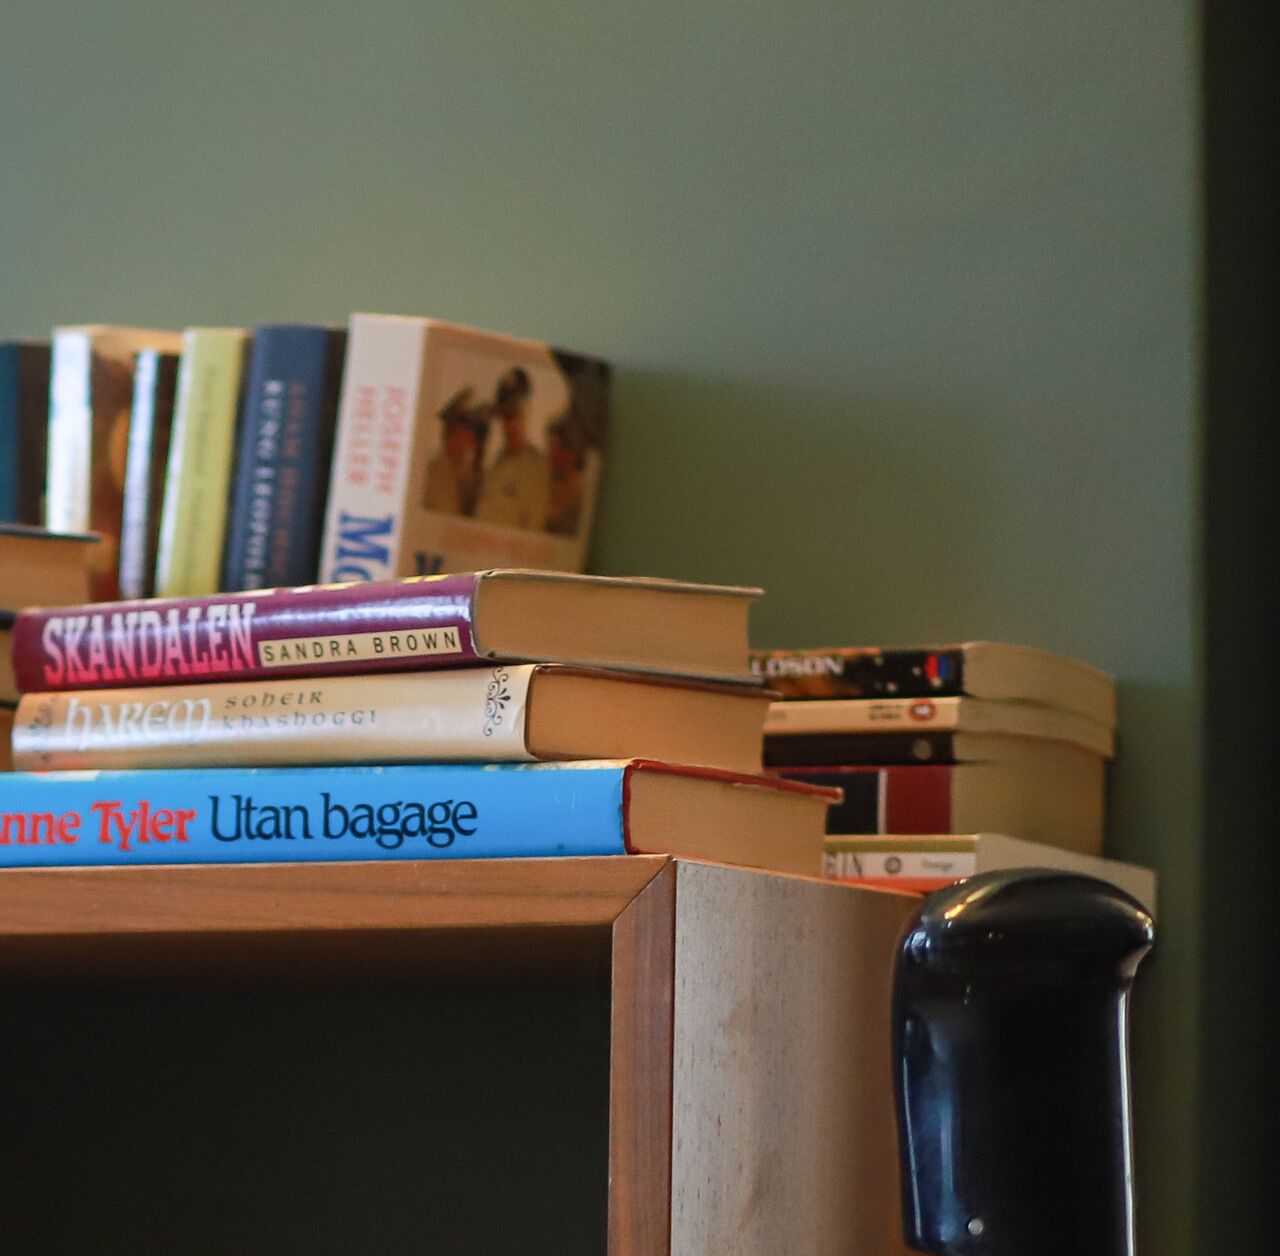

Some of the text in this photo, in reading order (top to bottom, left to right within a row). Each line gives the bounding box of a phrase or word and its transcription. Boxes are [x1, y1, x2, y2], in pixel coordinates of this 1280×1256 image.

[348, 385, 378, 486] HELLER
[375, 386, 407, 494] JOSEPH
[41, 601, 258, 686] SKANDALEN
[262, 630, 458, 662] SANDRA BROWN
[91, 799, 197, 851] Tyler
[209, 794, 310, 842] Utan
[320, 793, 478, 850] bagage
